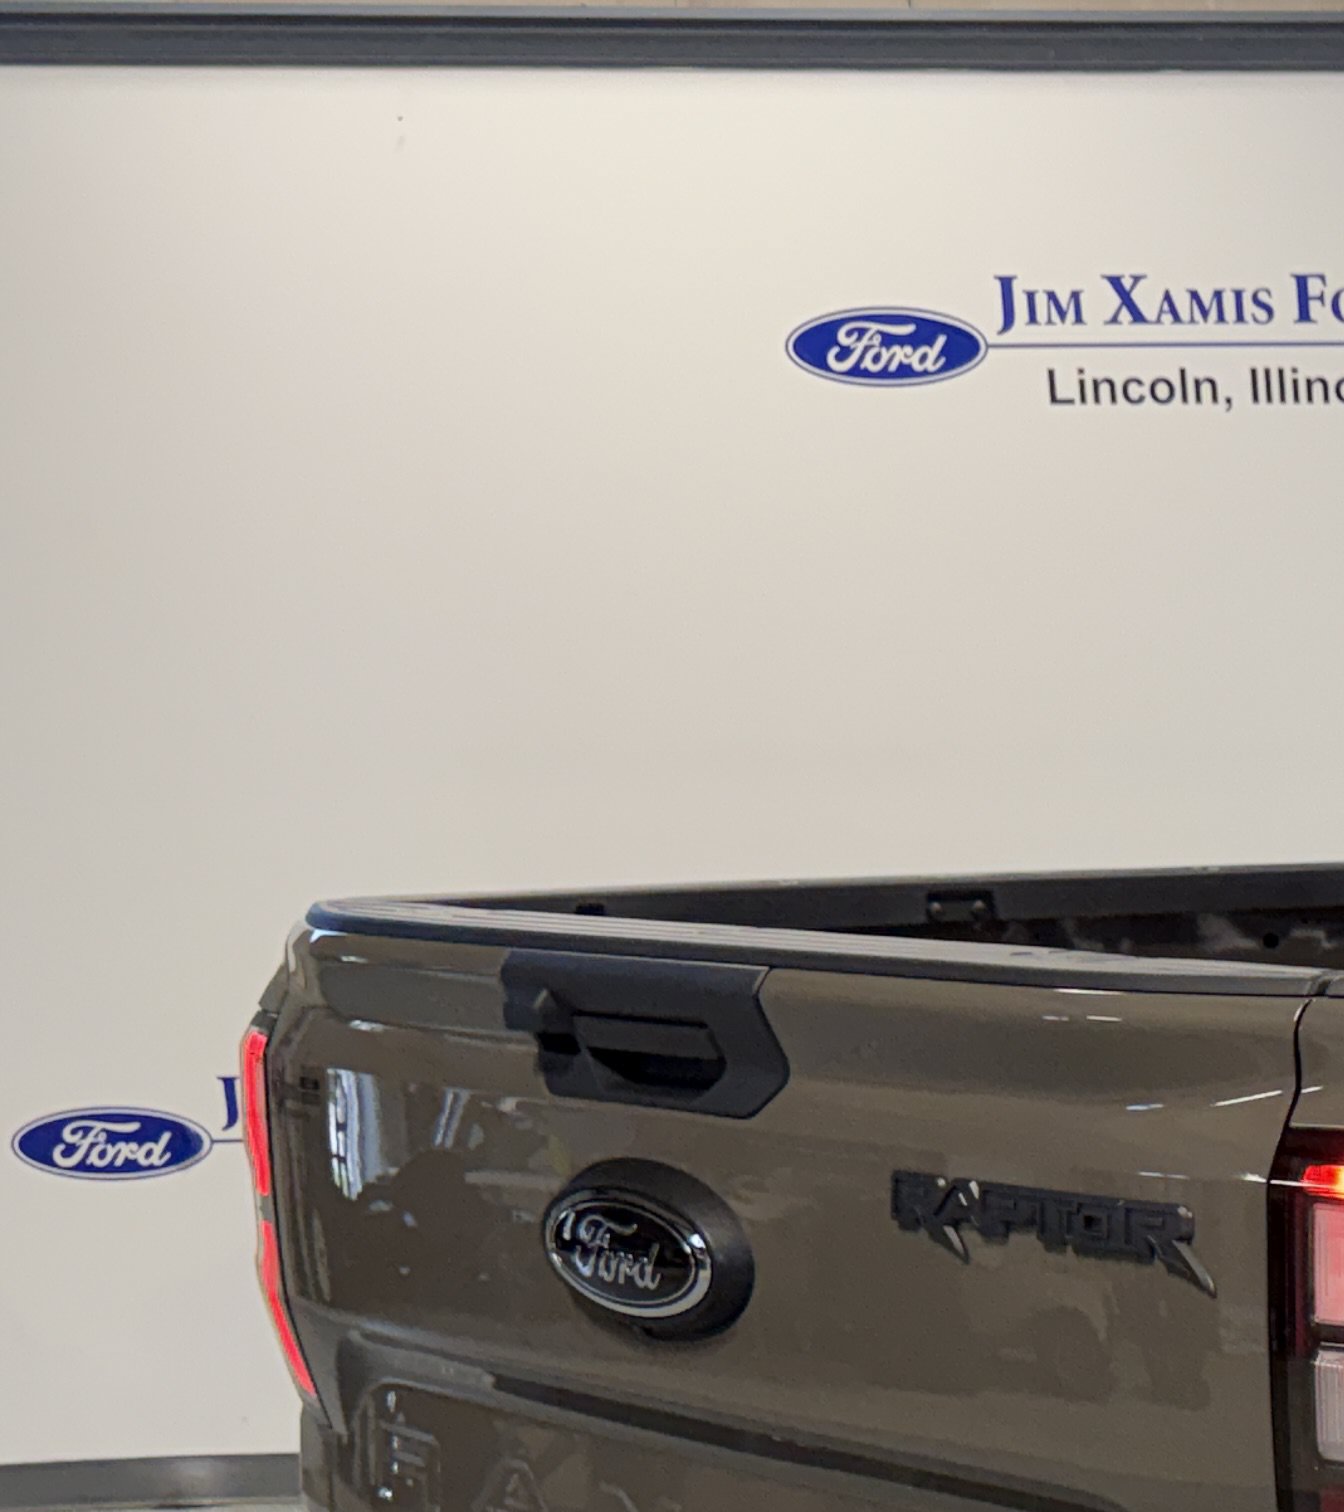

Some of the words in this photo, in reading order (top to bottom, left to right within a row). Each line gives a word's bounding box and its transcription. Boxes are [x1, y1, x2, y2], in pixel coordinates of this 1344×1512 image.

[993, 275, 1087, 336] JIM
[1101, 273, 1276, 326] XAMIS
[825, 320, 947, 374] Ford
[1046, 367, 1234, 412] Lincoln,
[52, 1119, 173, 1169] Ford
[577, 1213, 663, 1292] Ford
[891, 1169, 1219, 1300] RAPTOR
